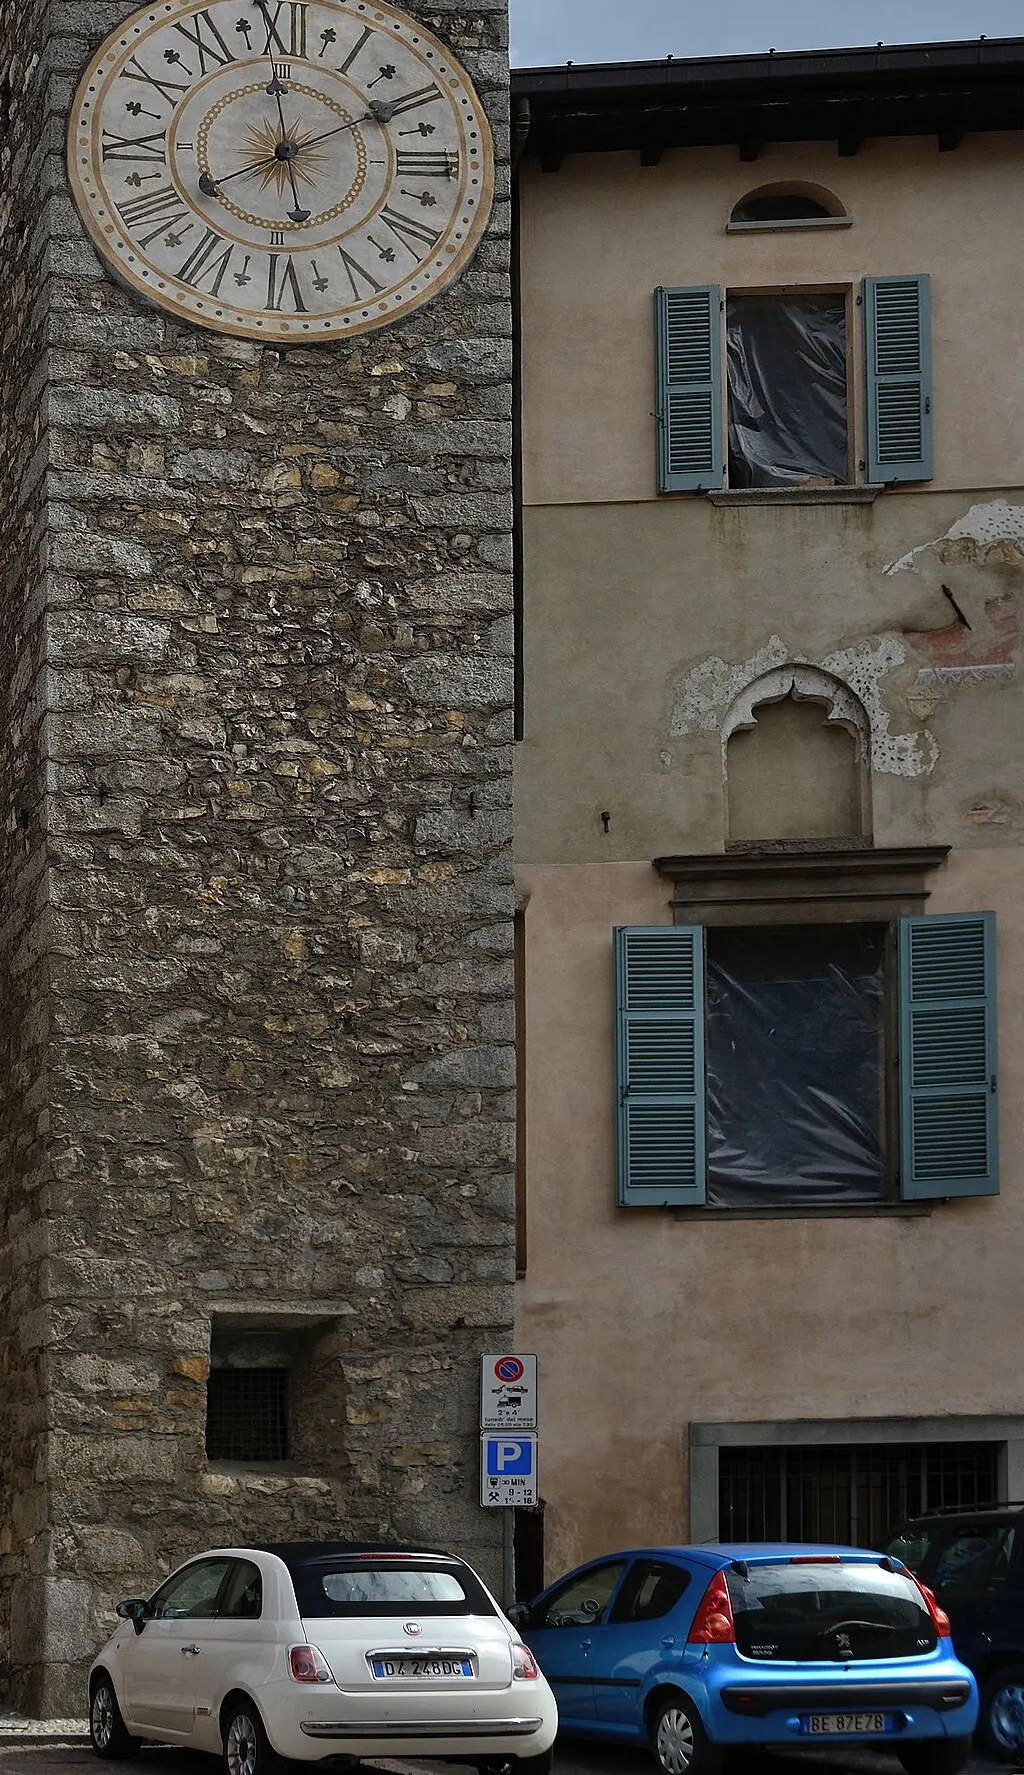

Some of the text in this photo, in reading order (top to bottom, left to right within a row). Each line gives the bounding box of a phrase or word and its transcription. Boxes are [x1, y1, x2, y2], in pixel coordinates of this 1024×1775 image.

[171, 9, 238, 77] XI
[260, 0, 311, 61] XII
[335, 25, 377, 76] I
[119, 55, 192, 109] X
[387, 82, 445, 119] II
[102, 128, 167, 165] IX
[176, 142, 193, 151] II
[396, 149, 459, 177] III
[114, 183, 190, 250] VIII
[269, 231, 284, 246] III
[378, 203, 444, 264] IV
[173, 226, 235, 298] VII
[263, 253, 310, 313] VI
[338, 245, 388, 303] V
[497, 1442, 522, 1471] P
